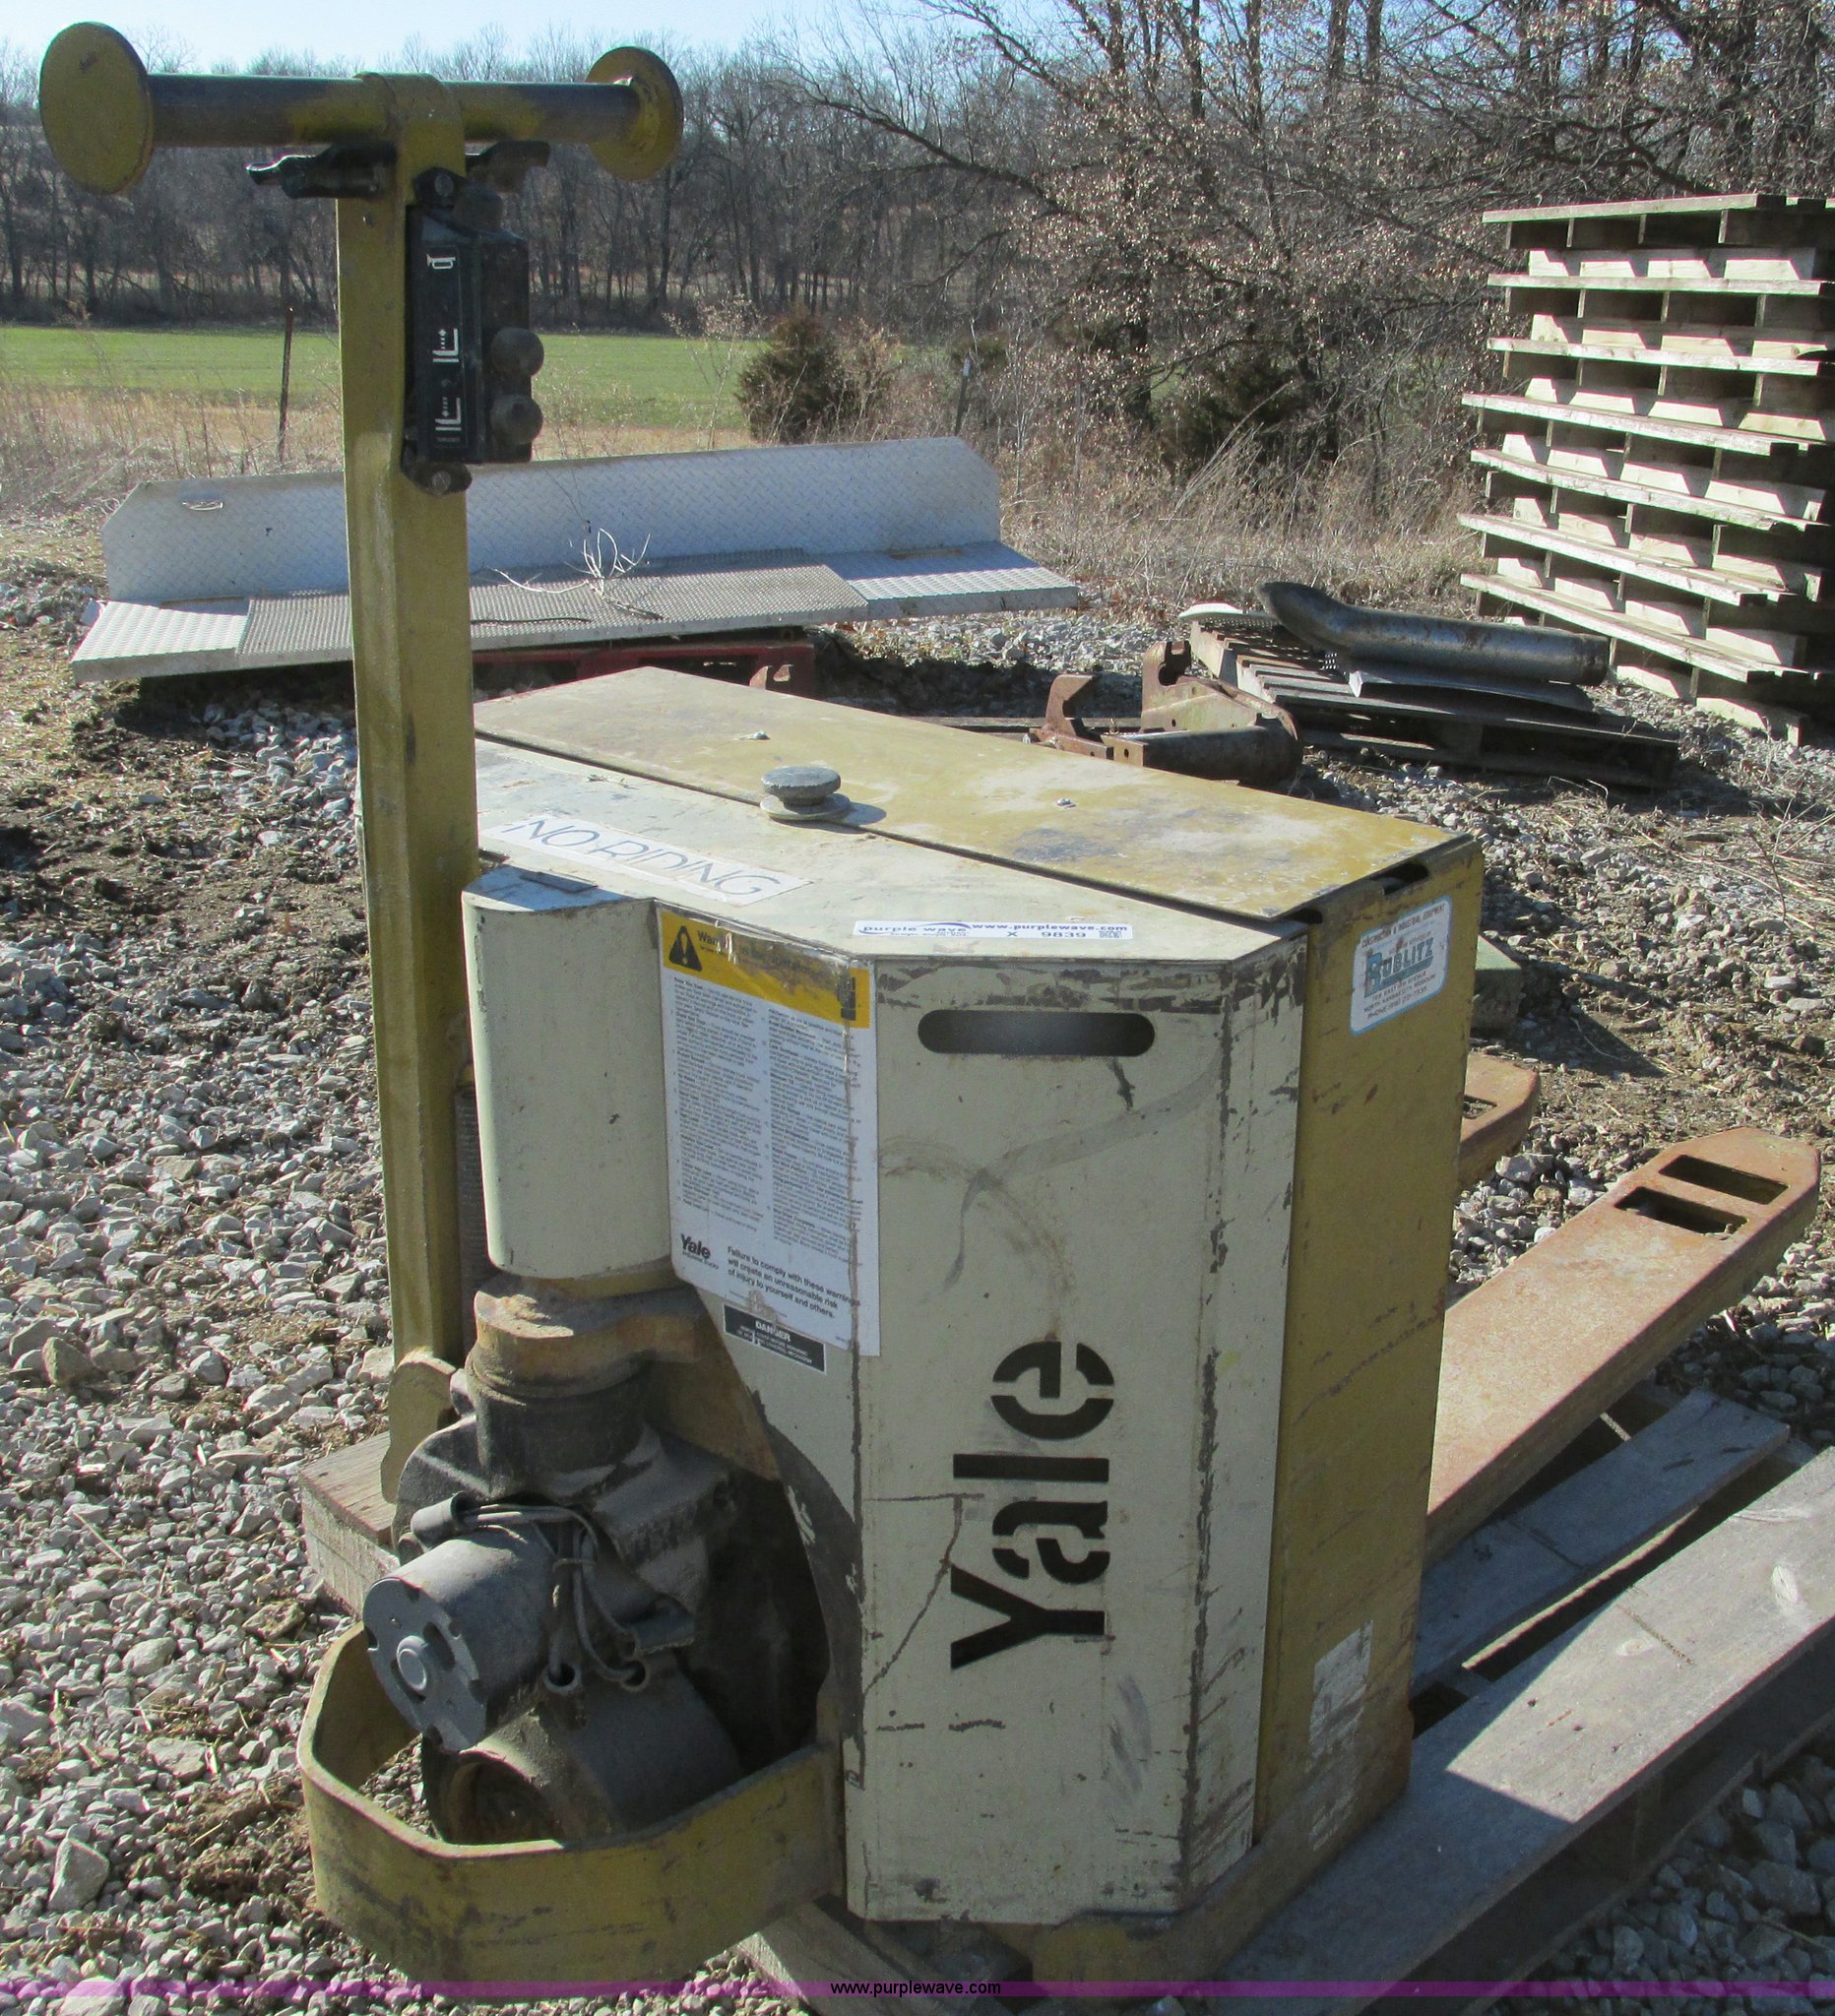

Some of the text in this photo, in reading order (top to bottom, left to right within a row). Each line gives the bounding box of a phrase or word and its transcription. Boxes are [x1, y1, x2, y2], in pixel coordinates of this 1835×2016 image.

[501, 819, 781, 896] NO RIDING
[680, 1232, 711, 1259] Yale
[728, 1245, 751, 1262] Failure
[752, 1256, 759, 1266] to
[760, 1261, 787, 1278] comply
[788, 1272, 803, 1284] with
[804, 1278, 824, 1292] these
[728, 1258, 739, 1268] will
[764, 1273, 773, 1282] an
[775, 1278, 823, 1302] unreasonable
[824, 1297, 839, 1309] risk
[728, 1268, 735, 1277] of
[736, 1272, 755, 1287] injury
[756, 1280, 764, 1289] to
[765, 1285, 793, 1300] yourself
[794, 1295, 808, 1307] and
[809, 1303, 835, 1319] others.
[950, 1341, 1115, 1670] Yale
